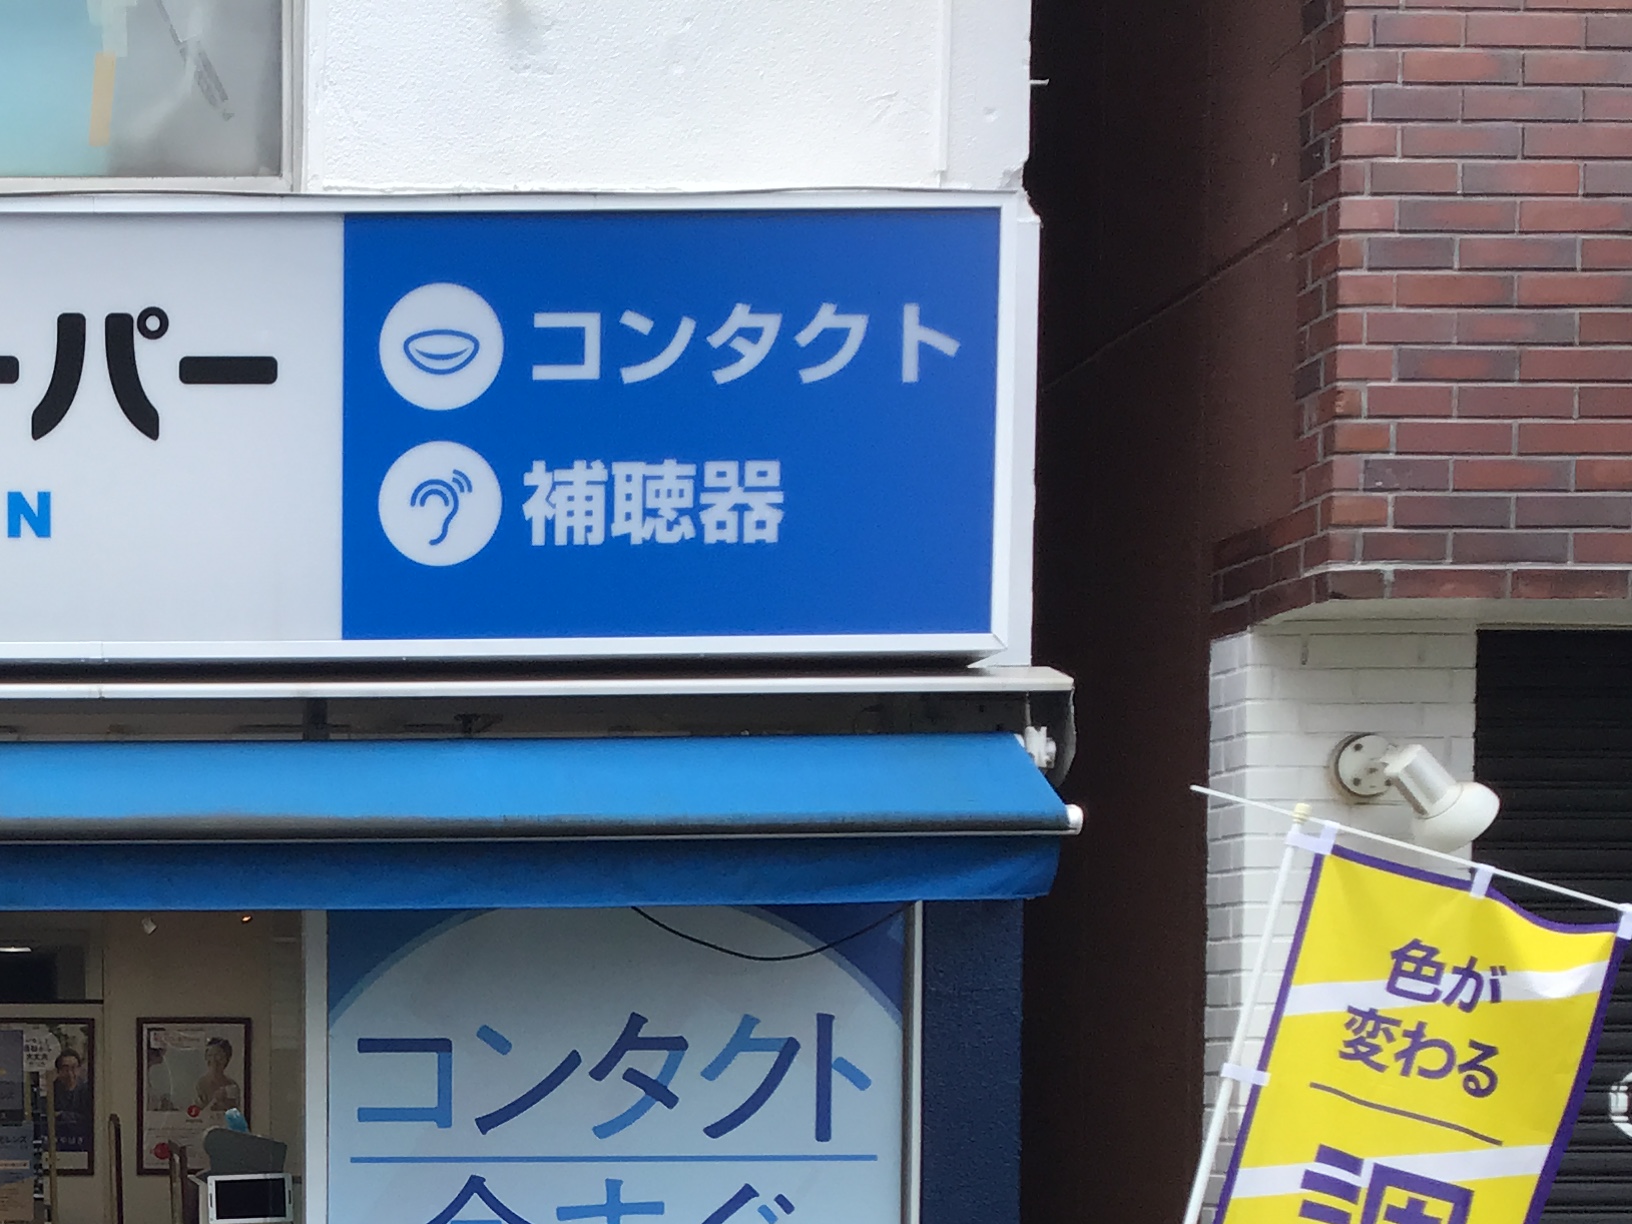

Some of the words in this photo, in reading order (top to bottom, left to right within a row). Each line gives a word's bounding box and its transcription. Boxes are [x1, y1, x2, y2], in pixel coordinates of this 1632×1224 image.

[531, 302, 962, 385] コンタクト
[522, 458, 785, 547] 補聴器
[1386, 938, 1507, 1013] 色が
[357, 1012, 872, 1143] コンタクト
[1339, 1005, 1499, 1098] 変わる
